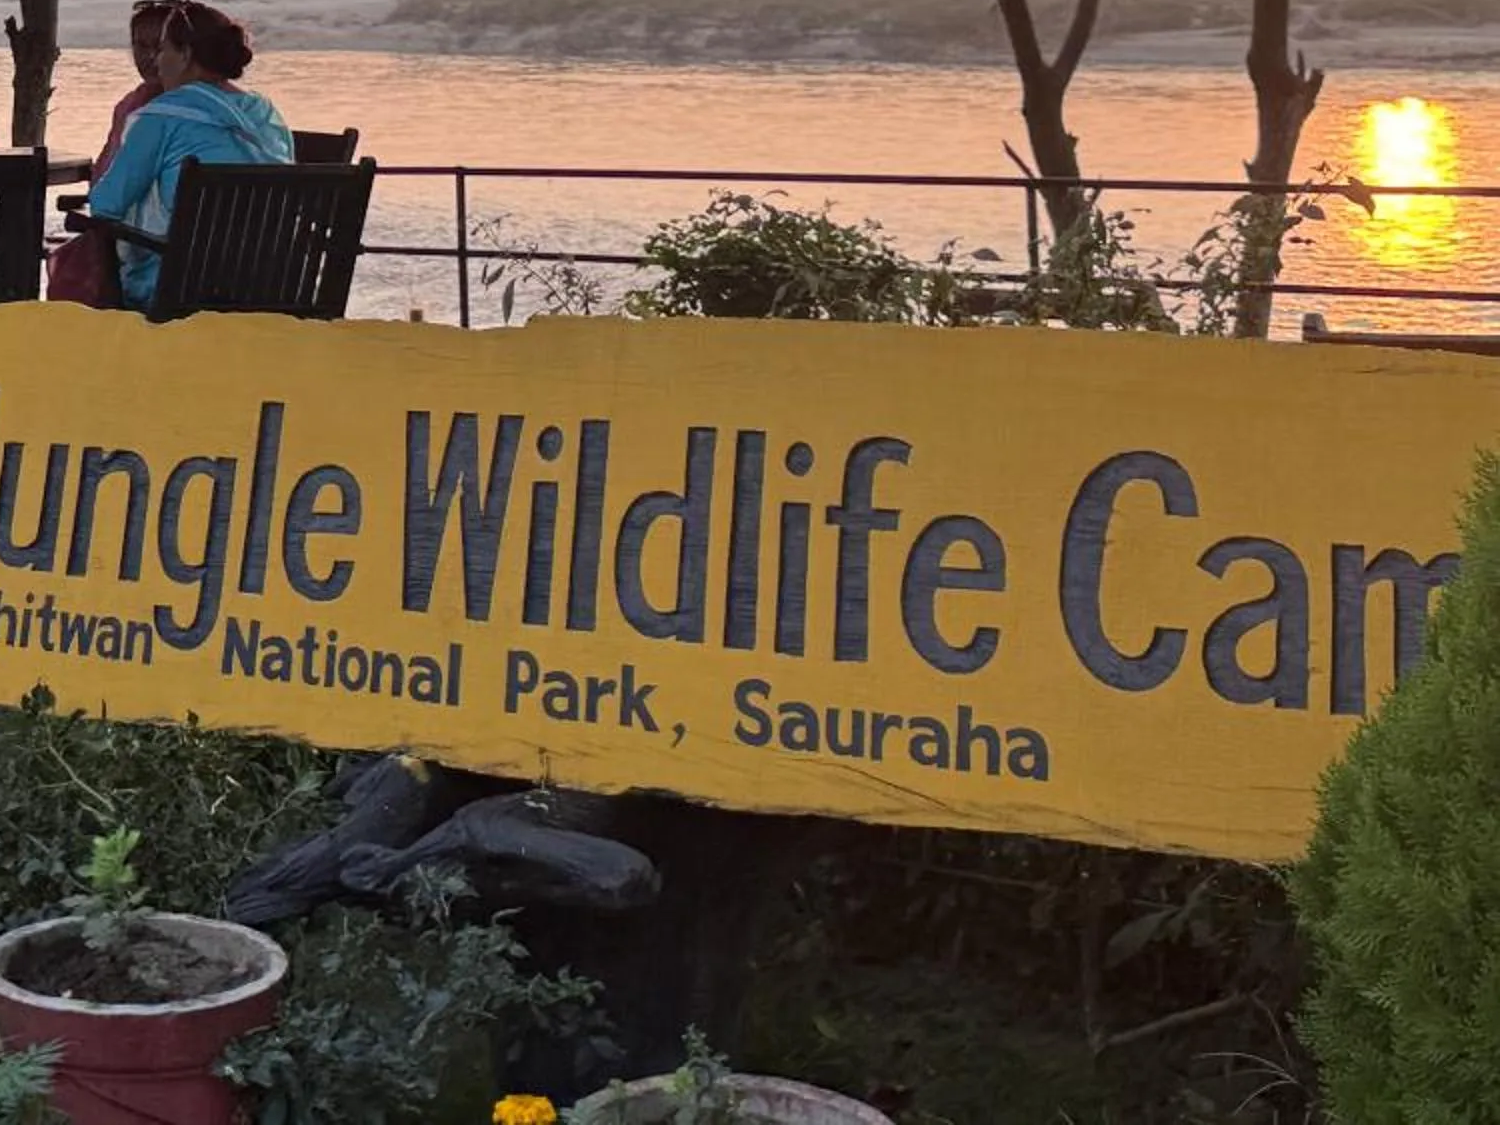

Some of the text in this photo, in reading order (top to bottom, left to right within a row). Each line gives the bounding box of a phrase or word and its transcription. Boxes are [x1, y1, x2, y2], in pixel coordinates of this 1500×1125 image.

[402, 411, 1006, 675] Wildlife
[221, 617, 463, 707] National
[503, 649, 688, 748] Park,
[733, 678, 1050, 782] Sauraha
